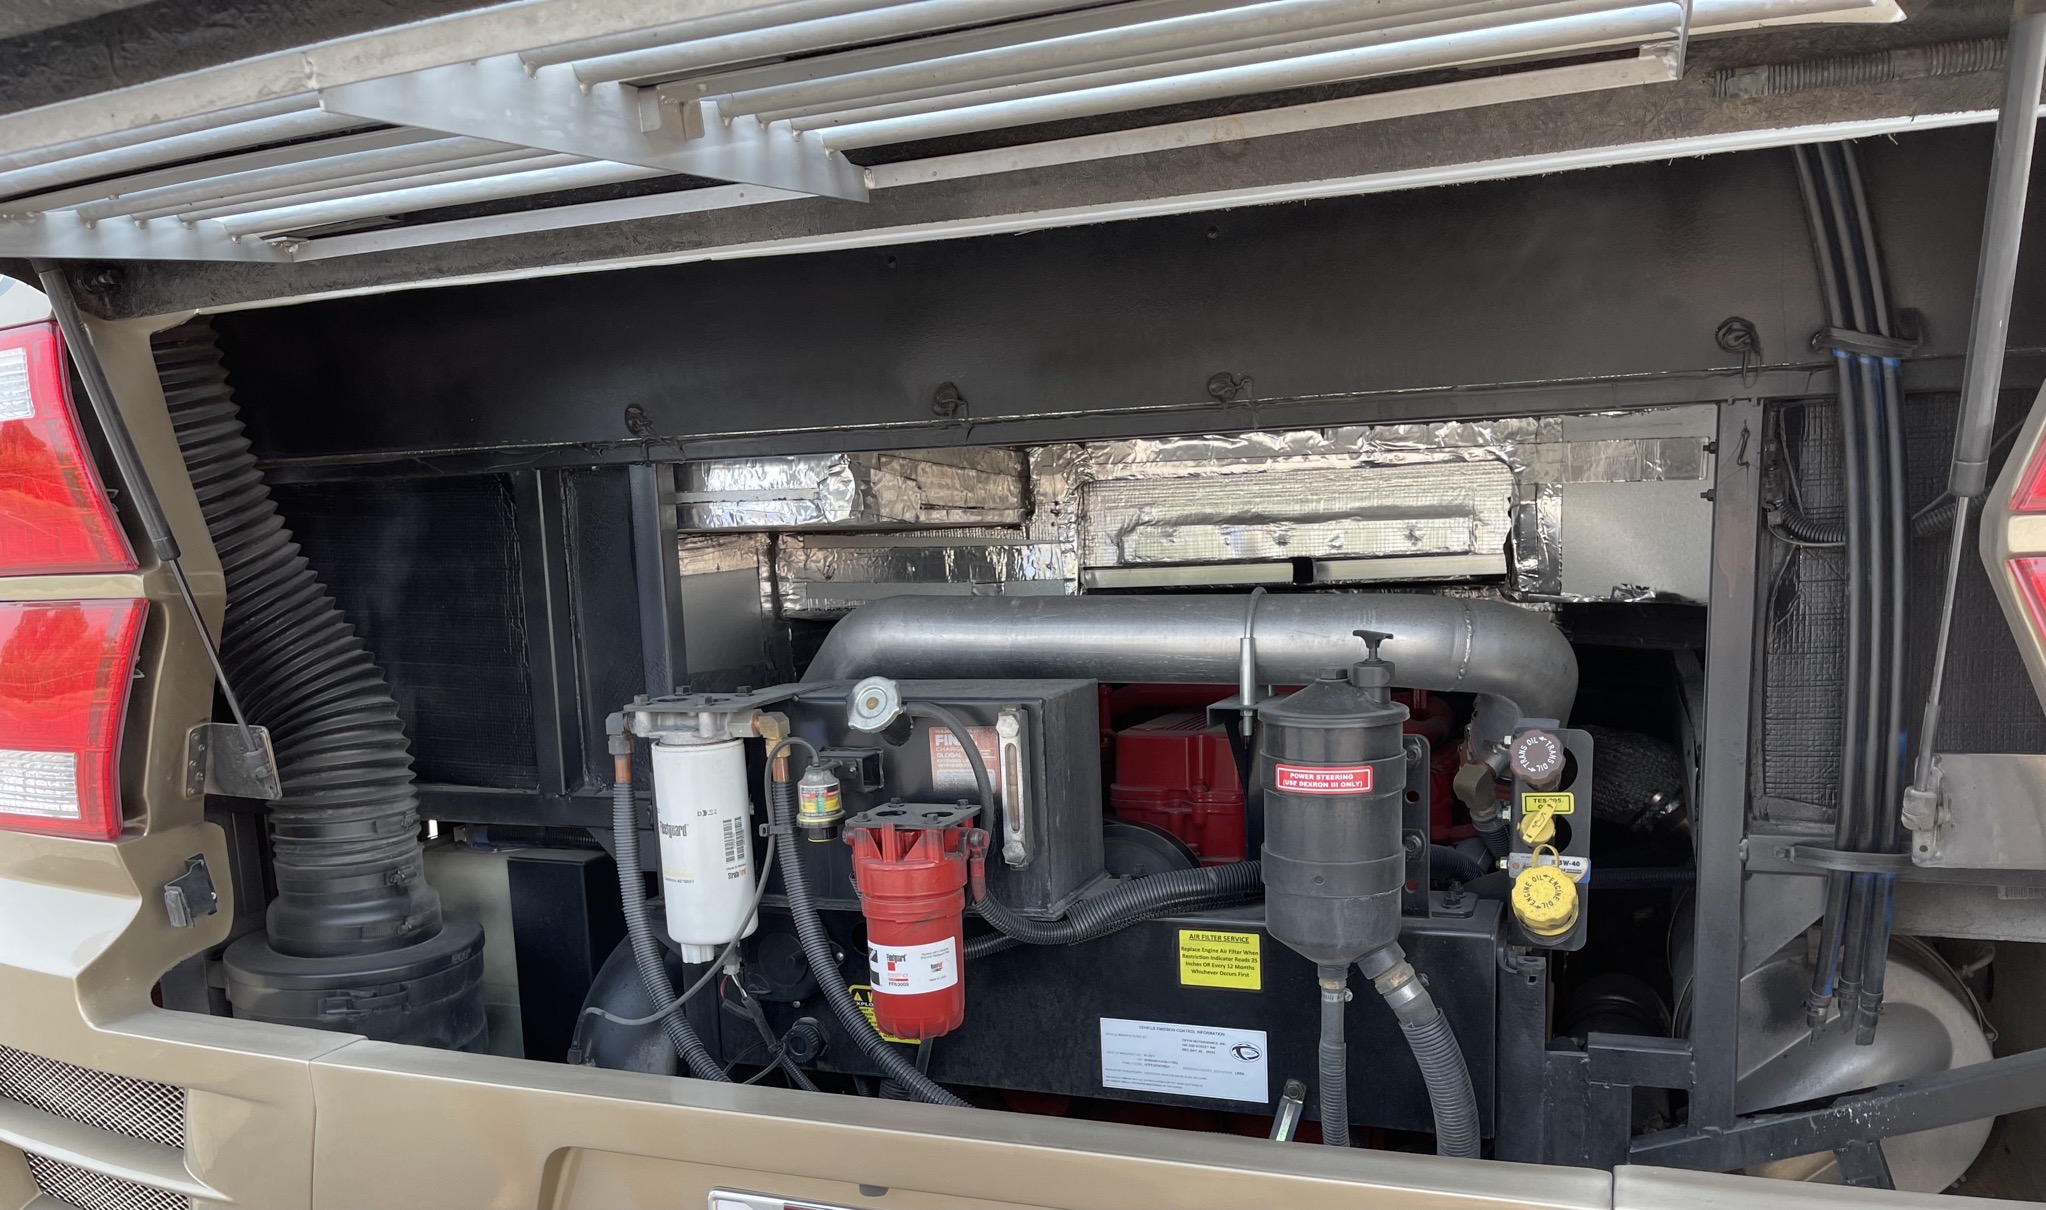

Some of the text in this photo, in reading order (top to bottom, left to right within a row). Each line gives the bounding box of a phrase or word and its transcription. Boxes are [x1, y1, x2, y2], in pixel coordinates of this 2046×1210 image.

[1519, 737, 1539, 768] TRANS OIL
[1536, 740, 1557, 772] TRANS OIL
[1289, 772, 1314, 780] POWER
[1340, 780, 1363, 788] ONLY)
[1523, 882, 1536, 906] ENGINE
[1531, 874, 1543, 883] OIL
[1542, 877, 1562, 909] ENGINE OIL
